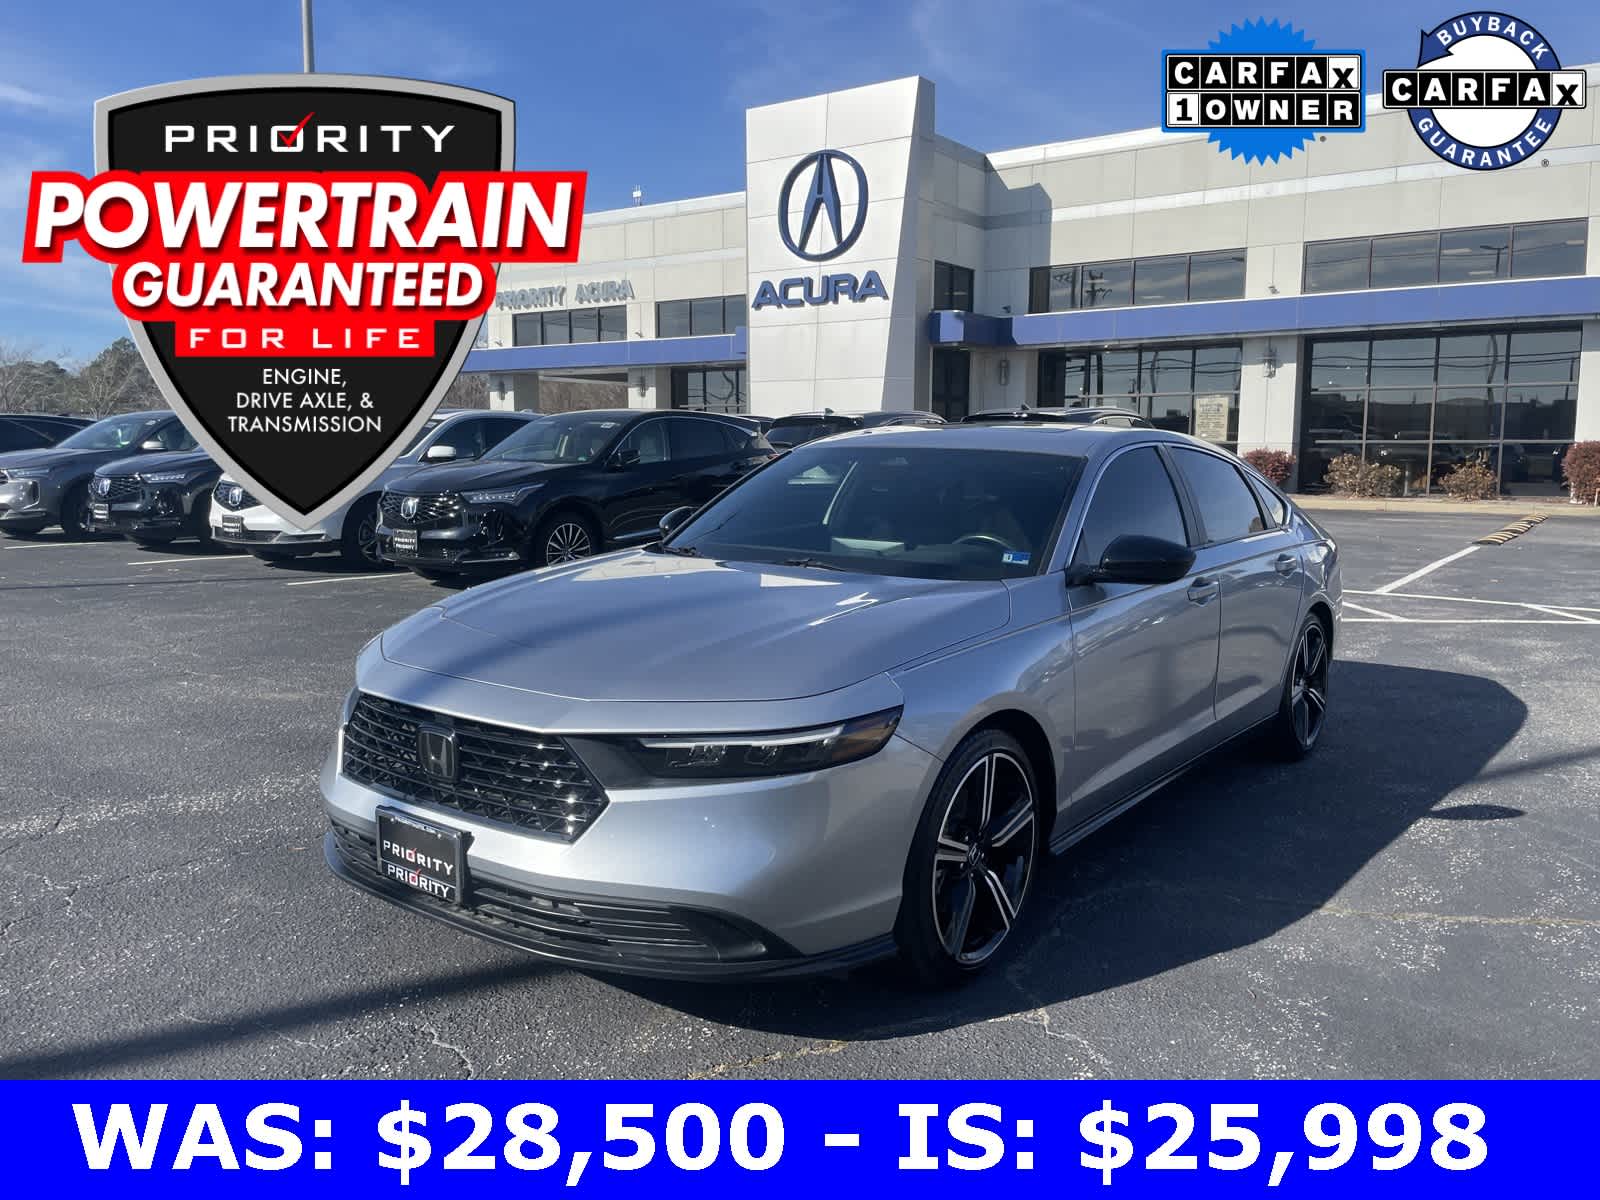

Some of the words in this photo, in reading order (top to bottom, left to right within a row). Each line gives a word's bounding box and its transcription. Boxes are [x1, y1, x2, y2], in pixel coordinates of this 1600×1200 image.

[495, 285, 567, 310] PRIORITY
[575, 280, 635, 304] ACURA
[752, 270, 889, 310] ACURA
[383, 840, 454, 875] PRIORITY
[387, 864, 449, 898] PRIORITY
